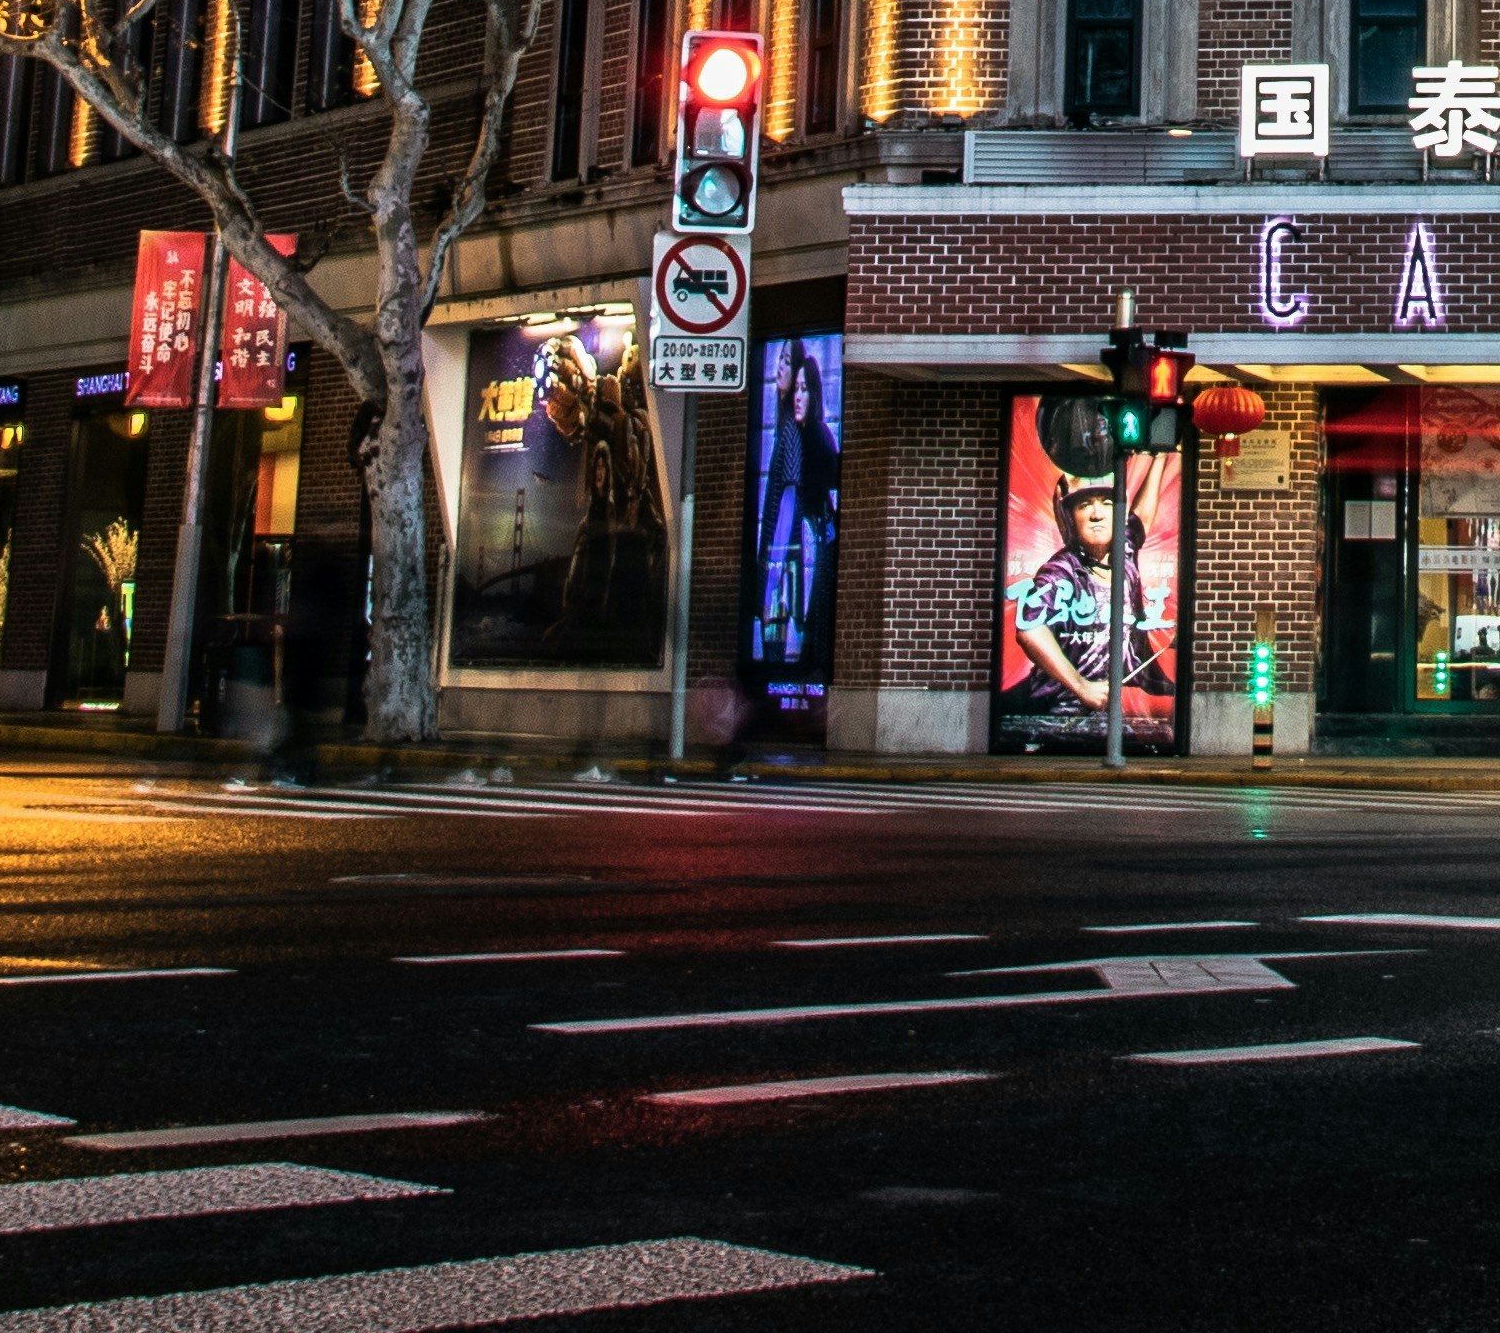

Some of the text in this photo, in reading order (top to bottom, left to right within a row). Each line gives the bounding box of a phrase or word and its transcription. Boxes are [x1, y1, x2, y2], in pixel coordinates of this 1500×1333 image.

[139, 290, 160, 375] 永远奋斗
[156, 279, 178, 364] 牢记使命
[175, 269, 196, 353] 不忘初心
[230, 278, 255, 369] 文明 和谐
[255, 329, 274, 367] 民主
[76, 373, 123, 397] SHANGHAI
[658, 361, 739, 382] 大型号牌
